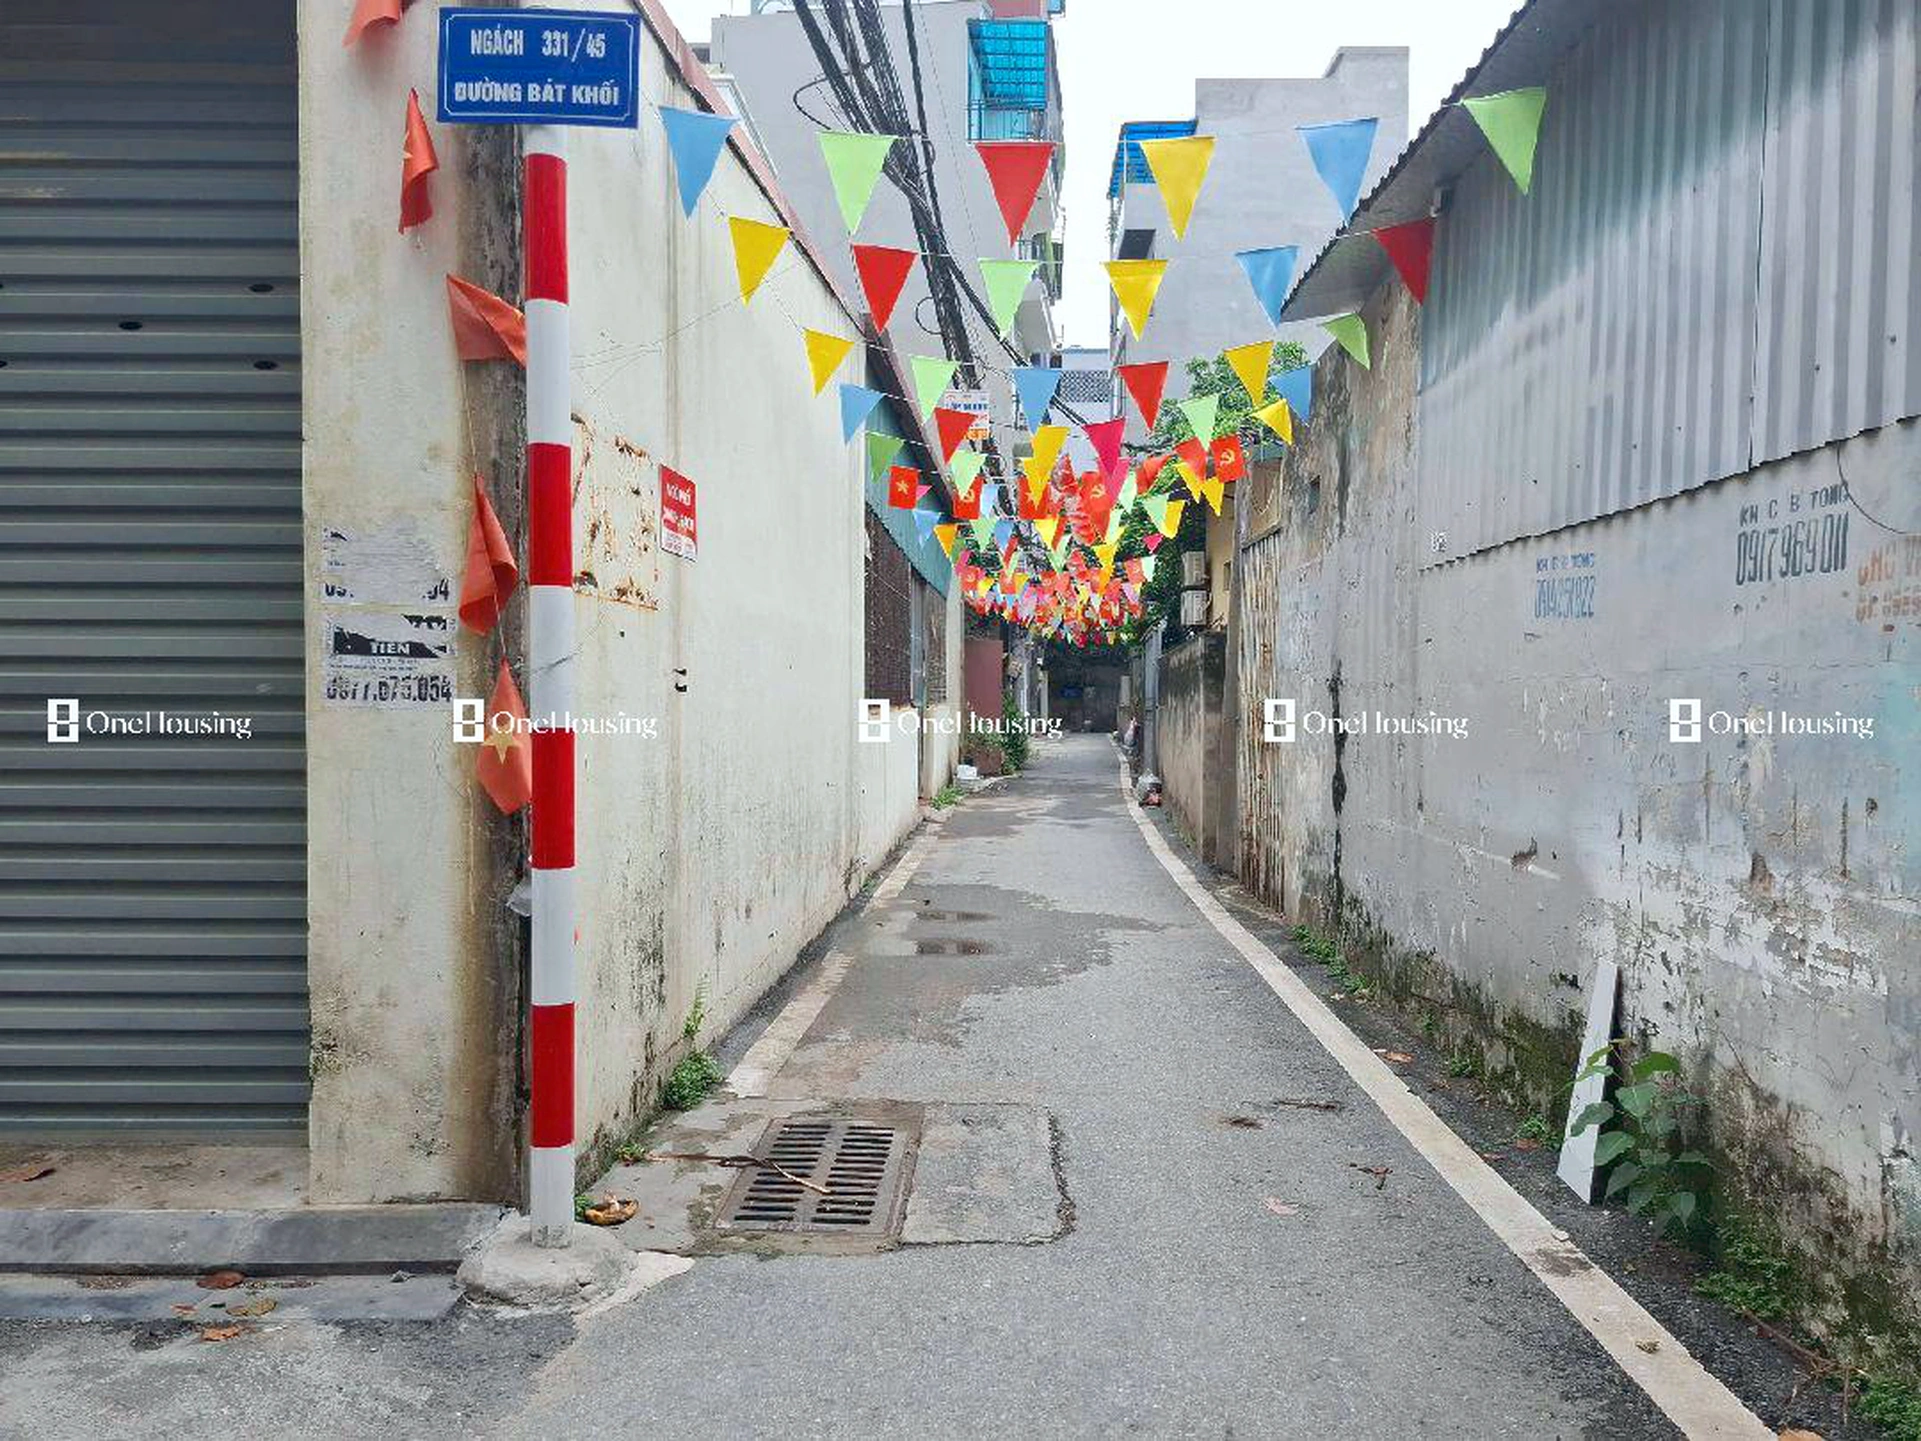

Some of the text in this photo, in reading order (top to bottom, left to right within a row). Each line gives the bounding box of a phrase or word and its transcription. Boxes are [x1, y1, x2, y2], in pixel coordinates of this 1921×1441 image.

[470, 24, 606, 62] NGÁCH 331/45
[454, 76, 619, 105] ĐƯỜNG BÁT KHỐI
